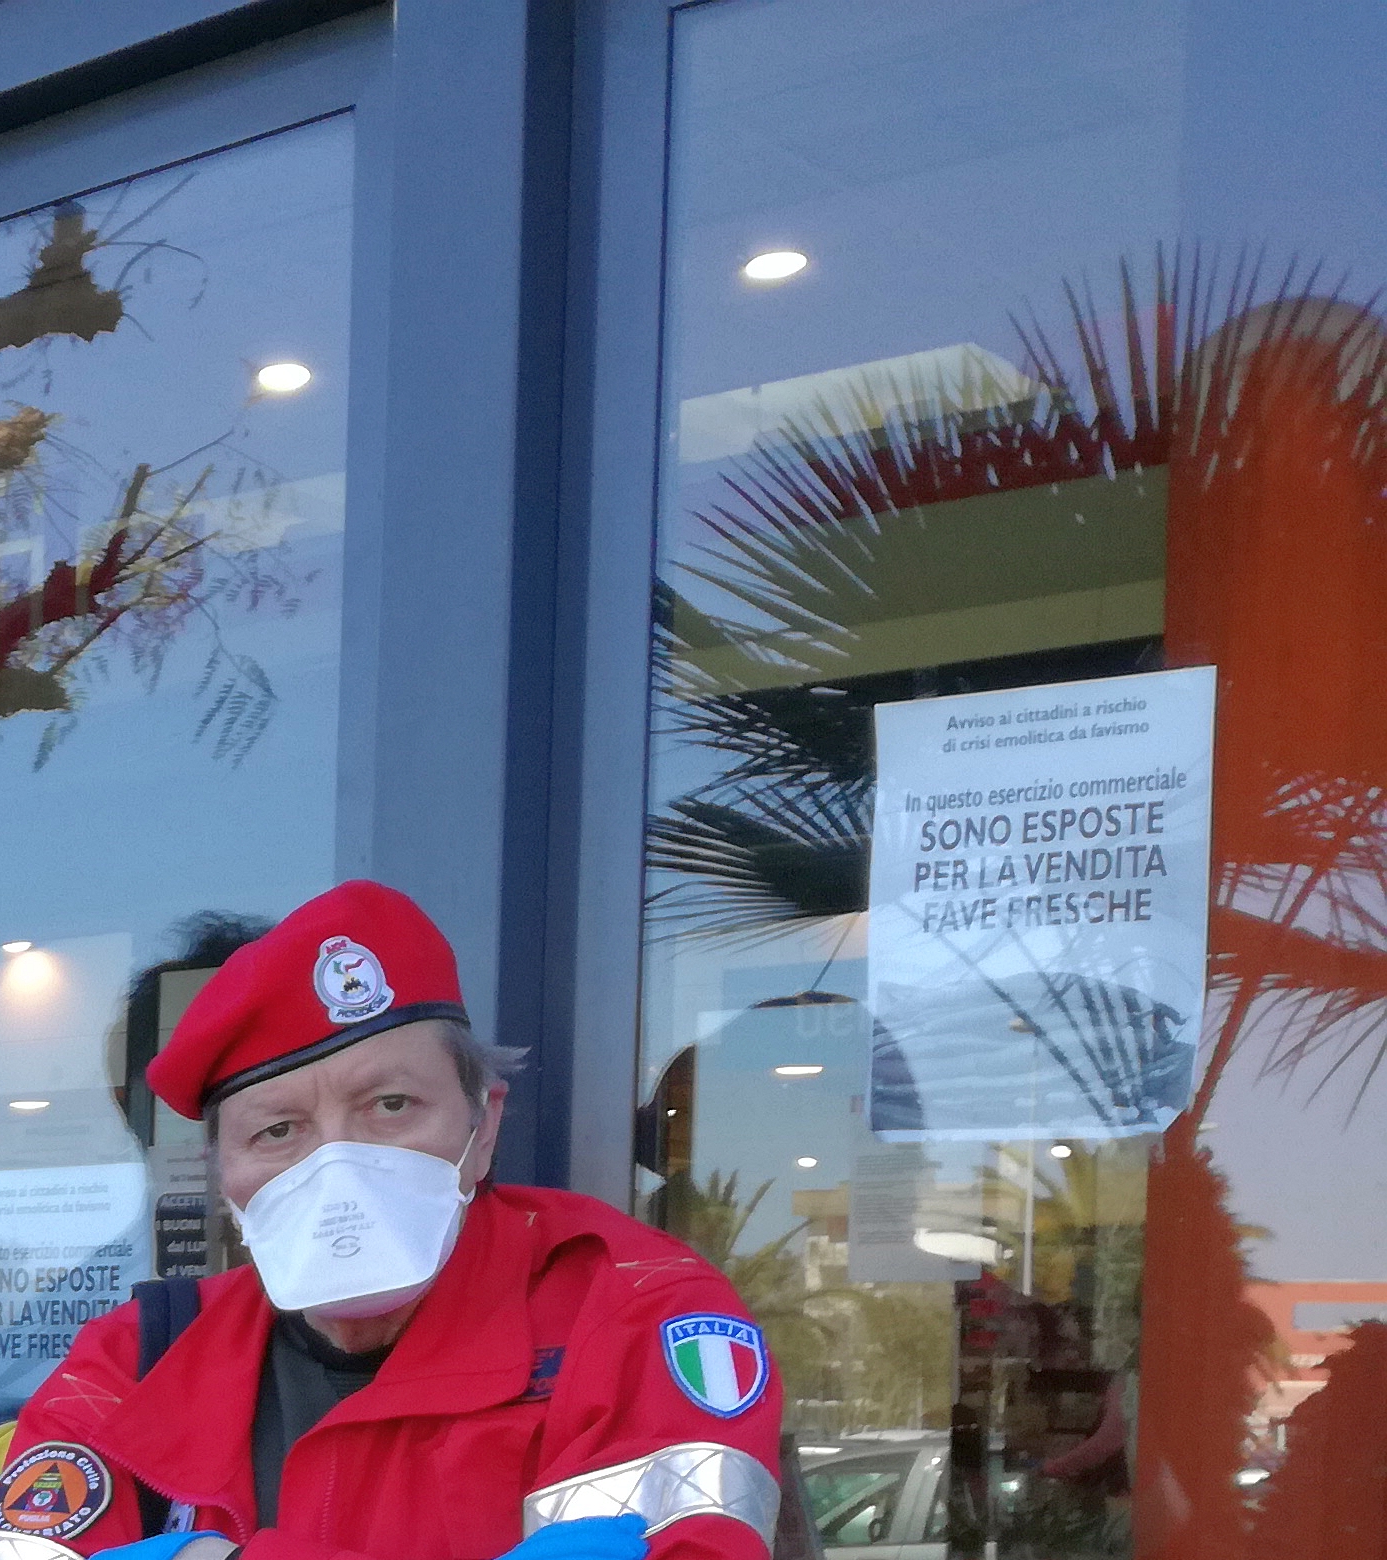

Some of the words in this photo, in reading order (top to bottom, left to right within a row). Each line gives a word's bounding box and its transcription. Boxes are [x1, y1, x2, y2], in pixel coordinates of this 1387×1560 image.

[947, 714, 994, 730] Avviso
[999, 712, 1011, 725] ai
[1016, 703, 1078, 724] cittadini
[1083, 706, 1091, 716] a
[1096, 698, 1147, 715] rischio
[942, 738, 956, 752] di
[961, 734, 990, 749] crisi
[995, 729, 1064, 748] emolitica
[1069, 725, 1086, 740] da
[1091, 720, 1149, 738] favismo
[906, 791, 921, 812] In
[927, 788, 982, 817] questo
[988, 778, 1063, 806] esercizio
[1069, 766, 1187, 799] commerciale
[920, 814, 1012, 852] SONO
[1022, 800, 1164, 844] ESPOSTE
[914, 858, 969, 892] PER
[979, 855, 1017, 889] LA
[1024, 844, 1167, 884] VENDITA
[923, 897, 999, 933] FAVE
[1007, 888, 1152, 928] FRESCHE
[34, 1265, 120, 1292] ESPOSTE
[9, 1300, 34, 1326] LA
[27, 1333, 73, 1359] FRES
[673, 1321, 749, 1341] ITALIA
[77, 1457, 101, 1490] Civile
